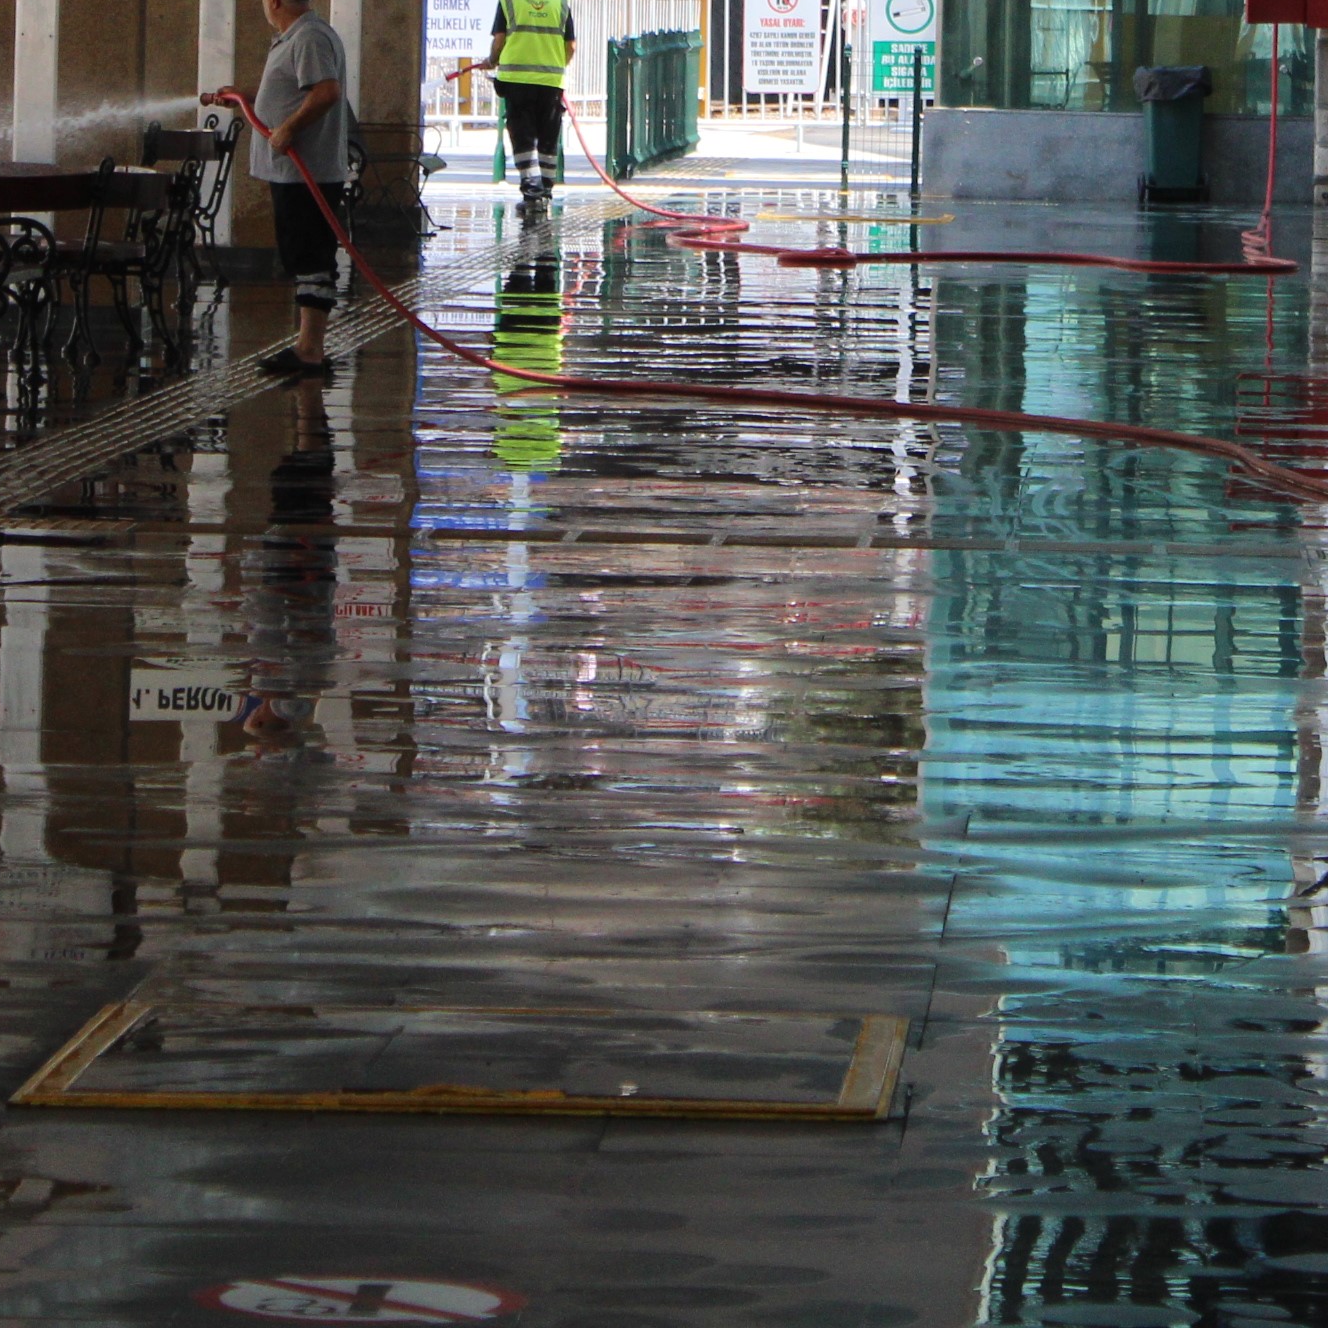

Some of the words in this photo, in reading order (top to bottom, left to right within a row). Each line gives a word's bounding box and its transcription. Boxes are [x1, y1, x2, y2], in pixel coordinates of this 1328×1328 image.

[426, 16, 467, 30] EHLİKELİ
[471, 18, 482, 31] VE
[760, 18, 780, 28] YASAL
[427, 37, 473, 50] YASAKTIR
[891, 44, 928, 53] SADEE
[898, 54, 936, 65] ALADA
[891, 65, 927, 77] SİGAA
[884, 76, 932, 89] İÇİLEBİR
